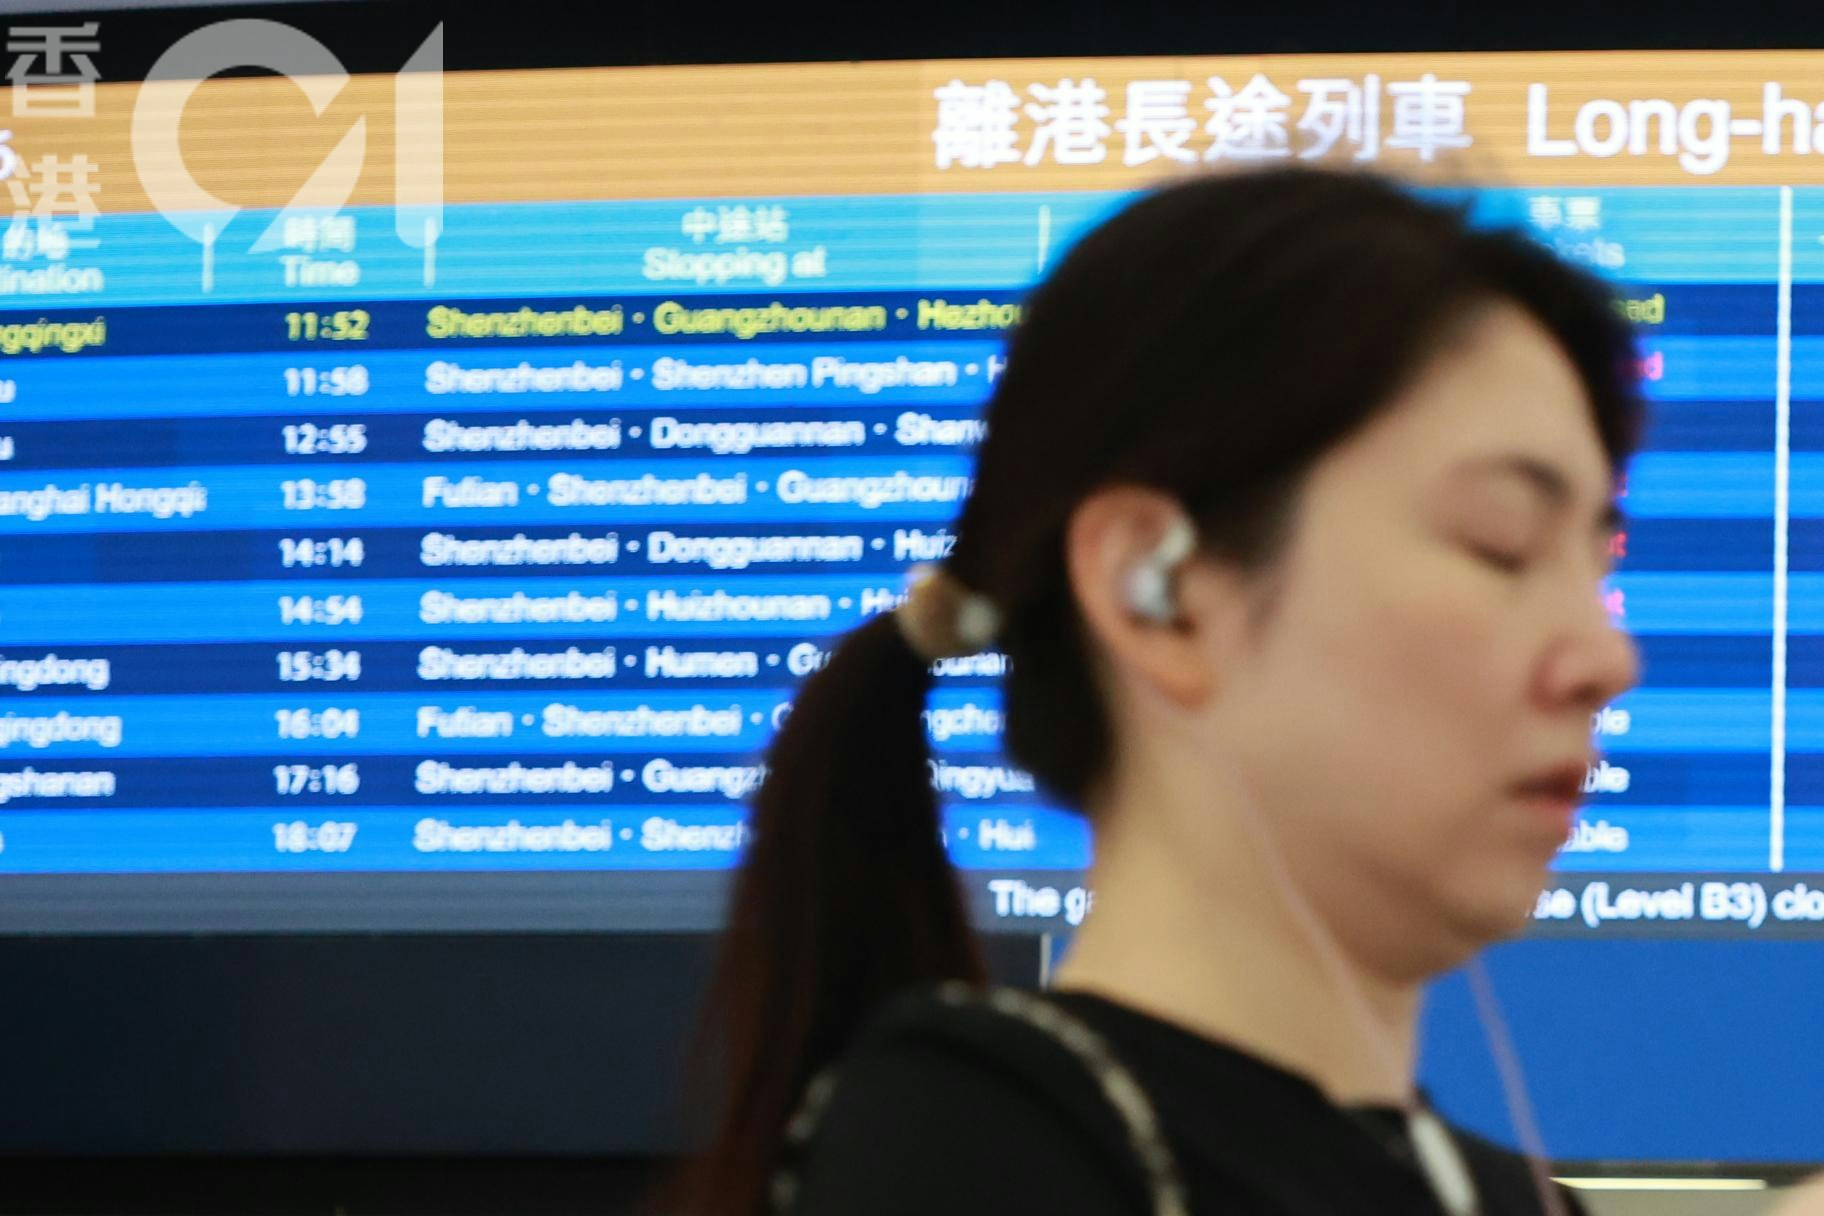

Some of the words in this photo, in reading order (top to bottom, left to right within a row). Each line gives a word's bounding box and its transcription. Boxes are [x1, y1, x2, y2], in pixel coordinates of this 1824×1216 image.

[280, 254, 361, 287] Time
[644, 248, 788, 286] Stopping
[793, 248, 826, 277] at
[288, 311, 370, 341] 11:52
[428, 307, 623, 339] Shenzhenbei
[655, 302, 887, 340] Guangzhounan
[427, 362, 624, 395] Shenzhenbei
[652, 357, 807, 392] Shenzhen
[812, 355, 958, 394] Pingshan
[424, 419, 621, 452] Shenzhenbei
[652, 418, 866, 455] Dongguannan
[424, 477, 519, 508] Futian
[549, 474, 748, 507] Shenzhenbei
[281, 539, 364, 566] 14:14
[422, 534, 619, 566] Shenzhenbei
[649, 533, 864, 570] Dongguannan
[421, 591, 618, 624] Shenzhenbei
[648, 591, 832, 622] Huizhounan
[419, 647, 616, 680] Shenzhenbei
[647, 647, 759, 678] Humen
[418, 707, 514, 738] Futian
[544, 705, 743, 737] Shenzhenbei
[276, 765, 360, 795] 17:16
[417, 761, 614, 794] Shenzhenbei
[414, 819, 613, 852] Shenzhenbei
[1582, 882, 1694, 930] (Level
[1700, 882, 1767, 930] B3)
